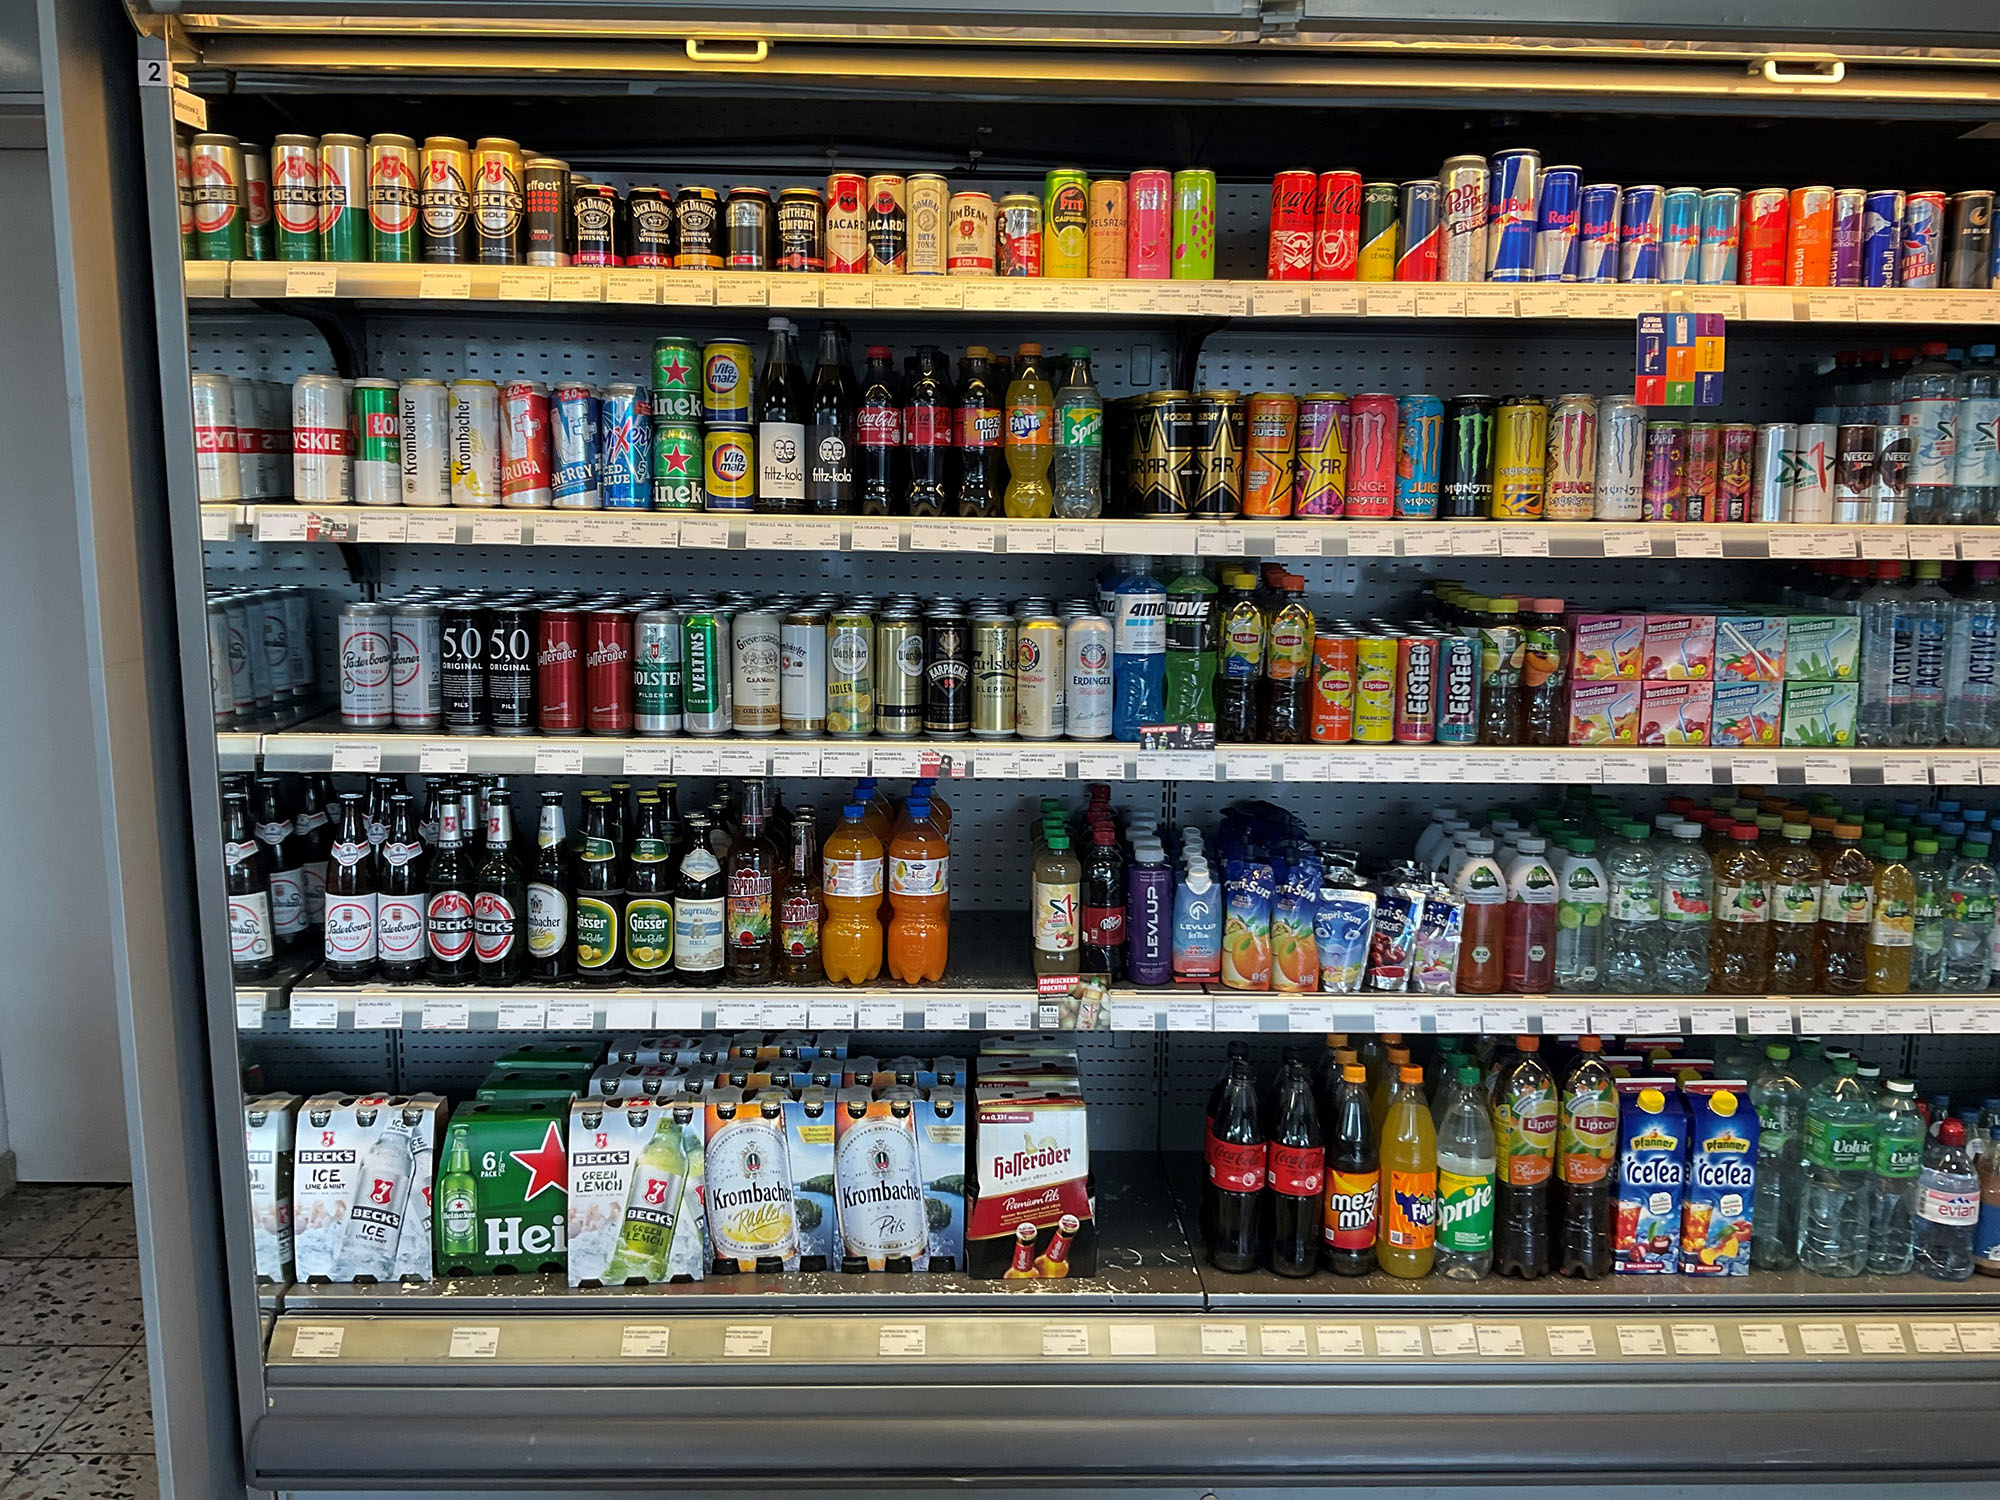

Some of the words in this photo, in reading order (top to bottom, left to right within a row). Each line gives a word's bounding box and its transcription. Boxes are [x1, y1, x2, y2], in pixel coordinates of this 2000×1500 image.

[148, 62, 161, 82] 2
[1461, 184, 1480, 199] Dr
[473, 192, 523, 209] BECK'S
[1509, 197, 1535, 213] Bull
[427, 210, 453, 218] GOLD
[482, 210, 508, 219] GOLD
[777, 207, 816, 221] SOUTHERN
[949, 207, 963, 226] JIM
[963, 205, 988, 225] BEAM
[1548, 210, 1574, 224] Red
[778, 219, 815, 231] COMFORT
[1584, 221, 1609, 235] Red
[1622, 223, 1644, 237] Red
[1669, 224, 1694, 236] Red
[1707, 225, 1732, 237] Red
[638, 235, 671, 244] WHISKEY
[680, 235, 711, 243] WHISKEY
[917, 240, 936, 249] TONIC
[581, 254, 607, 262] BERRY
[643, 256, 668, 265] COLA
[961, 258, 978, 267] COLA
[1370, 252, 1393, 260] LEMON
[1794, 248, 1804, 268] Bull
[1883, 250, 1894, 270] Bull
[1903, 264, 1936, 279] HORSE
[710, 372, 738, 385] malz
[856, 409, 898, 429] Coca-Cola
[1008, 414, 1041, 432] FANTA
[402, 398, 418, 476] Krombacher
[455, 399, 472, 477] Krombacher
[1252, 428, 1287, 437] JUICED
[719, 460, 747, 474] malz
[551, 463, 593, 488] ENERGY
[603, 473, 631, 486] BLUE
[763, 466, 804, 483] fritz-kola
[811, 466, 852, 484] fritz-kola
[1580, 618, 1622, 634] Durstlöscher
[1647, 619, 1691, 634] Durstlöscher
[1789, 620, 1834, 633] Durstlöscher
[441, 626, 483, 662] 5,0
[489, 628, 531, 662] 5,0
[1233, 634, 1259, 644] Lipton
[1276, 636, 1301, 646] Lipton
[691, 631, 705, 693] VELTINS
[1892, 630, 1912, 687] ACTIVE
[1916, 633, 1944, 689] ACTIVE
[1968, 629, 1997, 686] ACTIVE
[442, 661, 484, 671] ORIGINAL
[489, 663, 531, 672] ORIGINAL
[928, 660, 970, 681] KARPACKIE
[1073, 675, 1112, 685] ERDINGER
[1323, 680, 1350, 692] Lipton
[1363, 680, 1389, 692] Lipton
[1574, 684, 1616, 699] Durstlöscher
[1645, 685, 1688, 699] Durstlöscher
[1717, 685, 1759, 699] Durstlöscher
[1789, 686, 1833, 700] Durstlöscher
[438, 841, 463, 849] BECK'S
[679, 905, 720, 919] Bayreuther
[1316, 911, 1362, 926] Capri-Sun
[327, 918, 372, 936] Paderborner
[379, 920, 423, 936] Paderborner
[428, 918, 475, 931] BECK'S
[629, 913, 668, 931] Gösser
[1145, 886, 1160, 959] LEVLUP
[1179, 923, 1217, 931] LEVLUP
[688, 938, 709, 946] HELL
[391, 1119, 407, 1129] ICE
[1579, 1118, 1616, 1132] Lipton
[1632, 1137, 1675, 1150] pfanner
[1706, 1138, 1748, 1153] pfanner
[1832, 1139, 1873, 1154] Volvic
[300, 1150, 355, 1163] BECK'S
[482, 1151, 496, 1170] 6
[575, 1151, 629, 1165] BECK'S
[993, 1146, 1072, 1181] Hasseröder
[1890, 1151, 1921, 1165] Volvic
[312, 1169, 341, 1182] ICE
[581, 1170, 618, 1181] GREEN
[305, 1182, 323, 1190] LIME
[328, 1182, 346, 1190] MINT
[575, 1179, 623, 1193] LEMON
[712, 1180, 792, 1211] Krombacher
[843, 1179, 922, 1209] Krombacher
[1002, 1194, 1044, 1212] Premium
[1042, 1188, 1060, 1203] Pils
[443, 1210, 477, 1220] Heineken
[1435, 1184, 1493, 1232] Sprite
[1937, 1201, 1977, 1218] evian
[352, 1207, 400, 1229] BECK'S
[626, 1208, 673, 1229] BECK'S
[733, 1202, 785, 1231] Radler
[1338, 1208, 1375, 1229] mix
[361, 1223, 386, 1238] ICE
[632, 1224, 662, 1237] GREEN
[870, 1213, 906, 1240] Pils
[374, 1236, 388, 1244] MINT
[485, 1214, 568, 1256] Hei
[625, 1230, 665, 1247] LEMON
